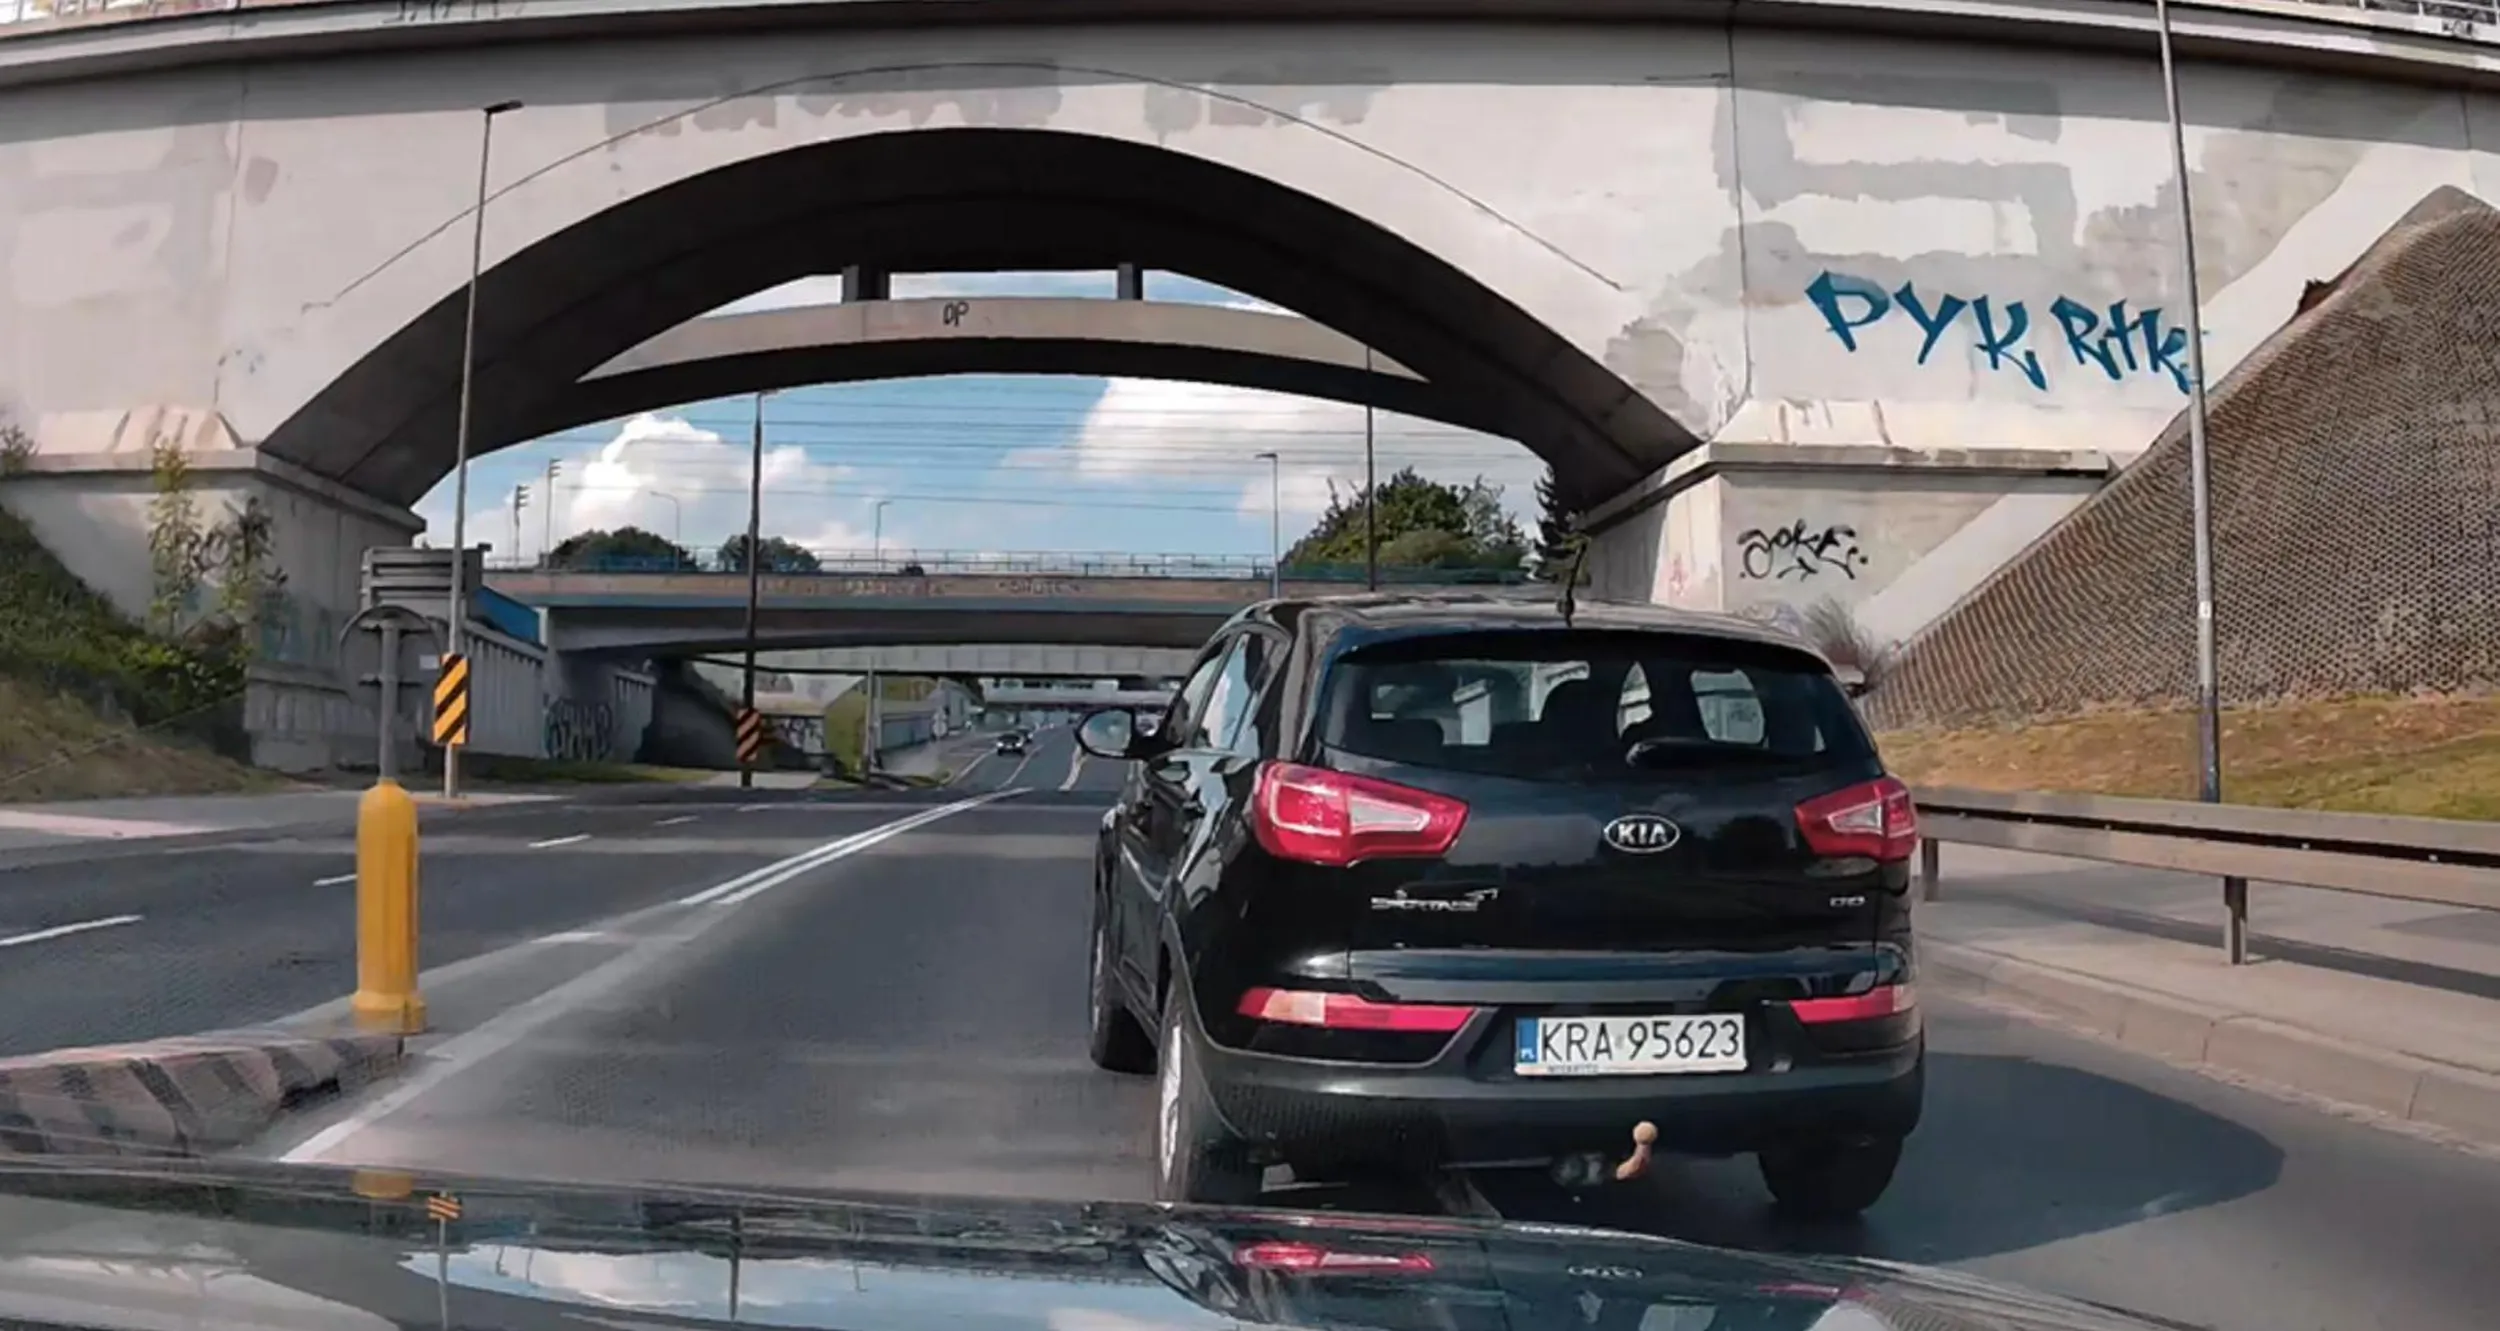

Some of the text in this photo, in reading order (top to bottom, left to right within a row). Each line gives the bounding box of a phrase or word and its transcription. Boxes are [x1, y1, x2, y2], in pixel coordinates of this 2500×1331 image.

[1618, 822, 1668, 844] KIA
[1541, 1019, 1739, 1062] KRA 95623
